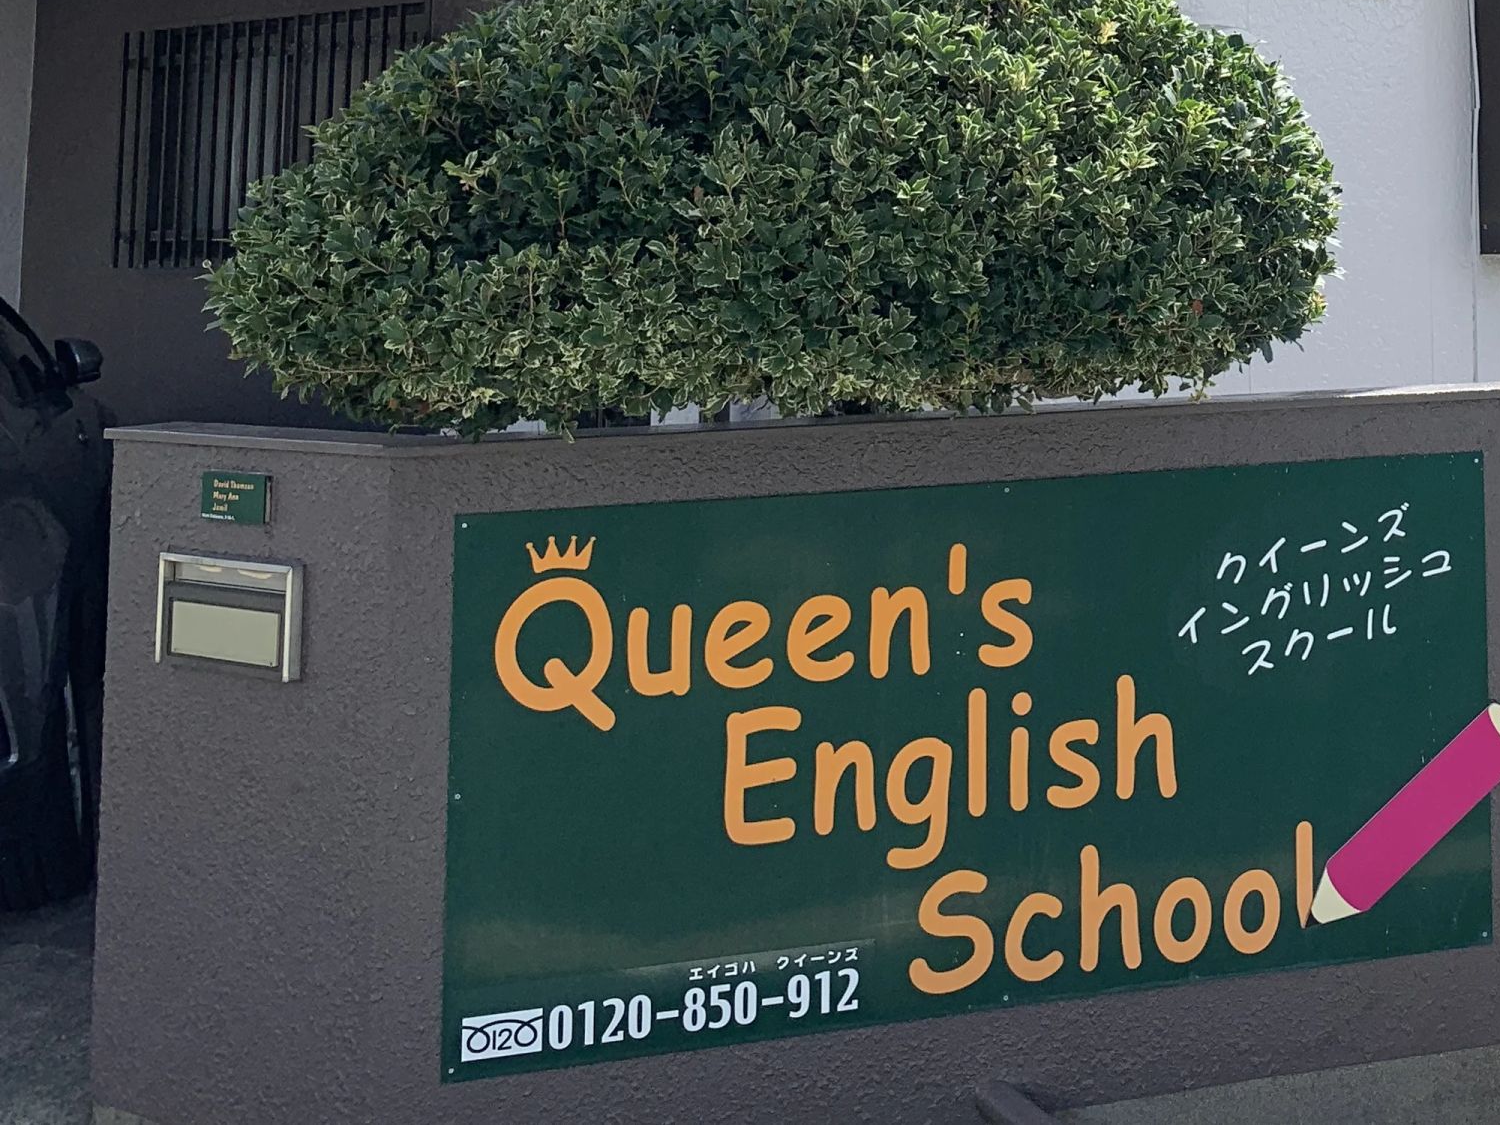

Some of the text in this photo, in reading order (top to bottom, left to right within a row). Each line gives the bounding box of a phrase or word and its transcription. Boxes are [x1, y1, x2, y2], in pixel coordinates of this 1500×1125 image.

[1216, 502, 1410, 584] クイーンズ
[494, 543, 1034, 732] Queen's
[1178, 550, 1452, 644] イングリッシュ
[1241, 603, 1397, 675] スクール
[724, 674, 1177, 869] English
[909, 821, 1313, 995] School
[688, 947, 859, 981] エイゴハ クイーンズ
[548, 967, 860, 1051] 0120-850-912
